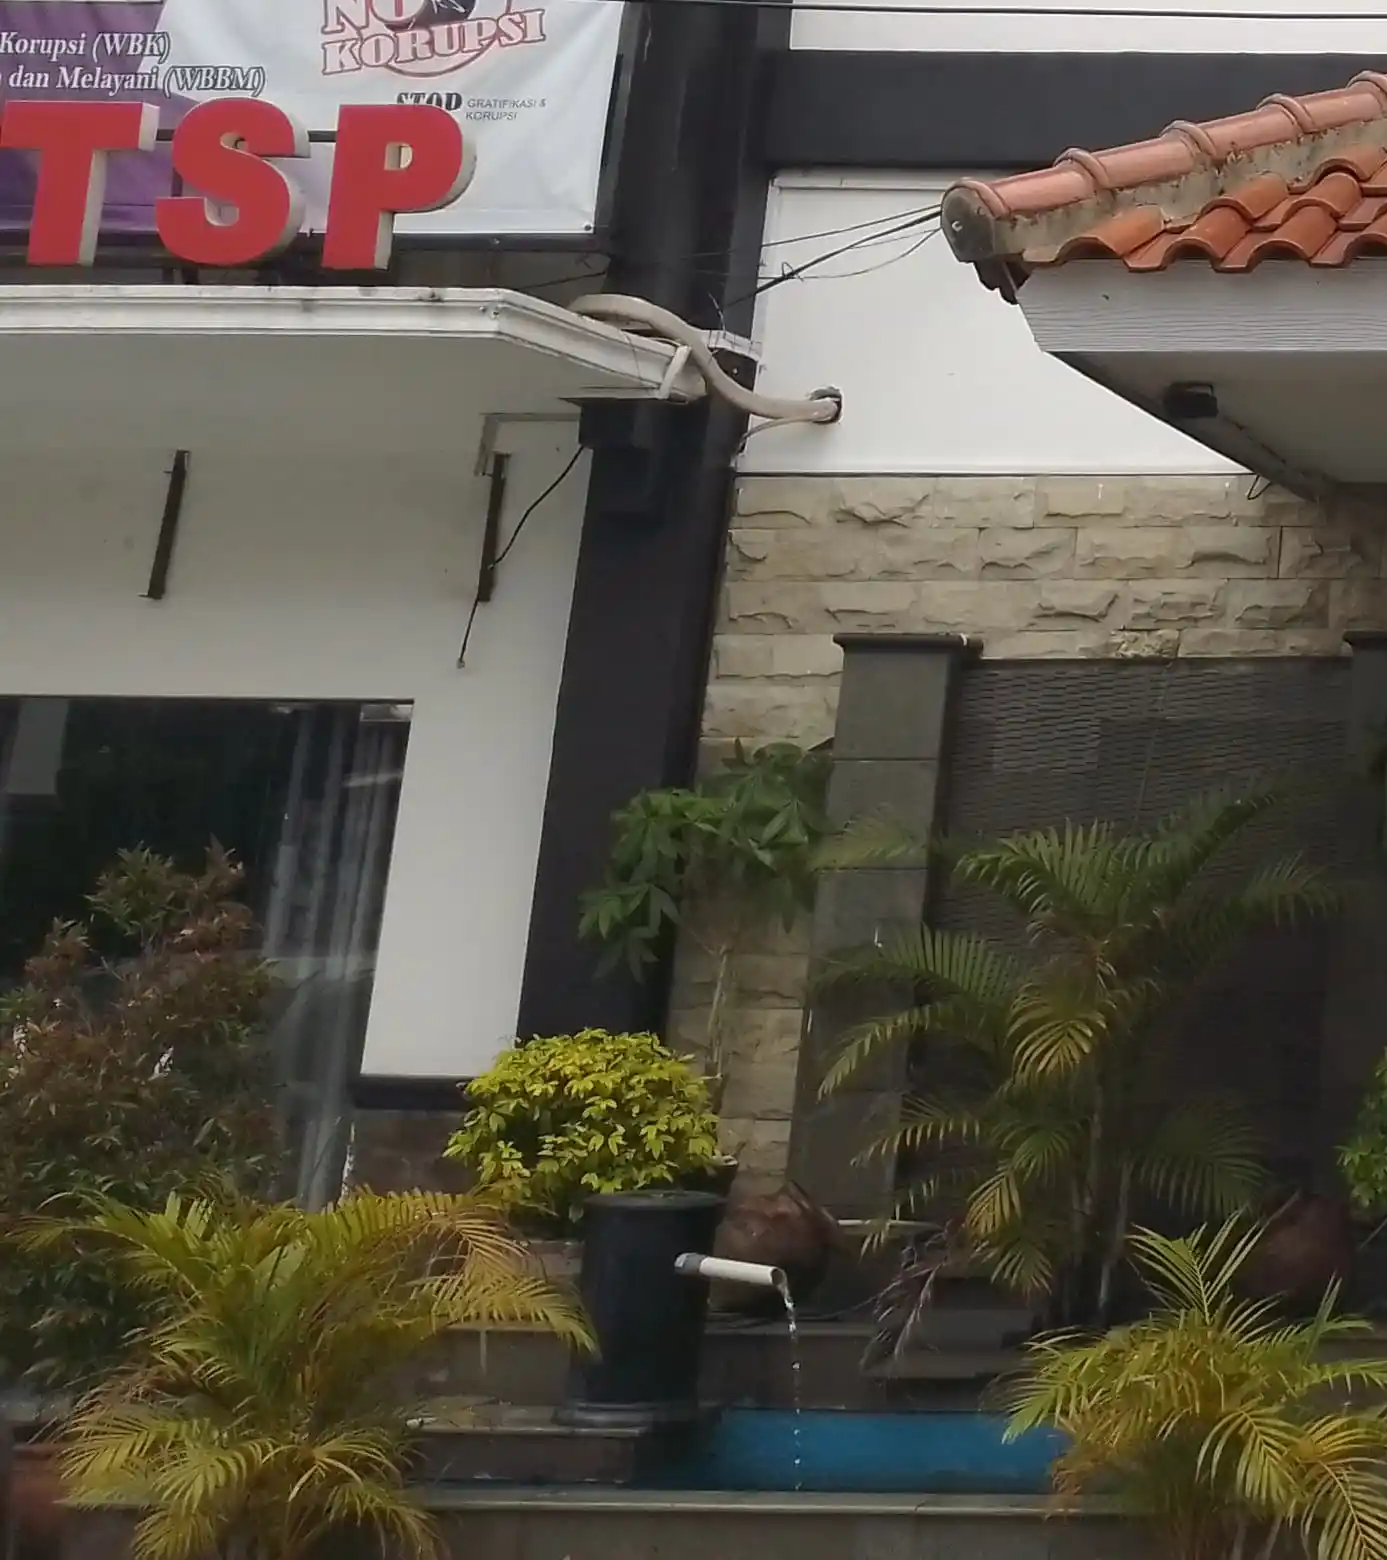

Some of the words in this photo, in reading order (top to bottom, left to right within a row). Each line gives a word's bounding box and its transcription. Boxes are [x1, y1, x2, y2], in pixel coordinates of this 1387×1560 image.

[0, 32, 87, 63] Korupsi
[92, 32, 172, 64] (WBK)
[321, 8, 547, 76] KORUPSI
[8, 64, 50, 88] dan
[56, 65, 159, 96] Melayani
[163, 65, 266, 99] (WBBM)
